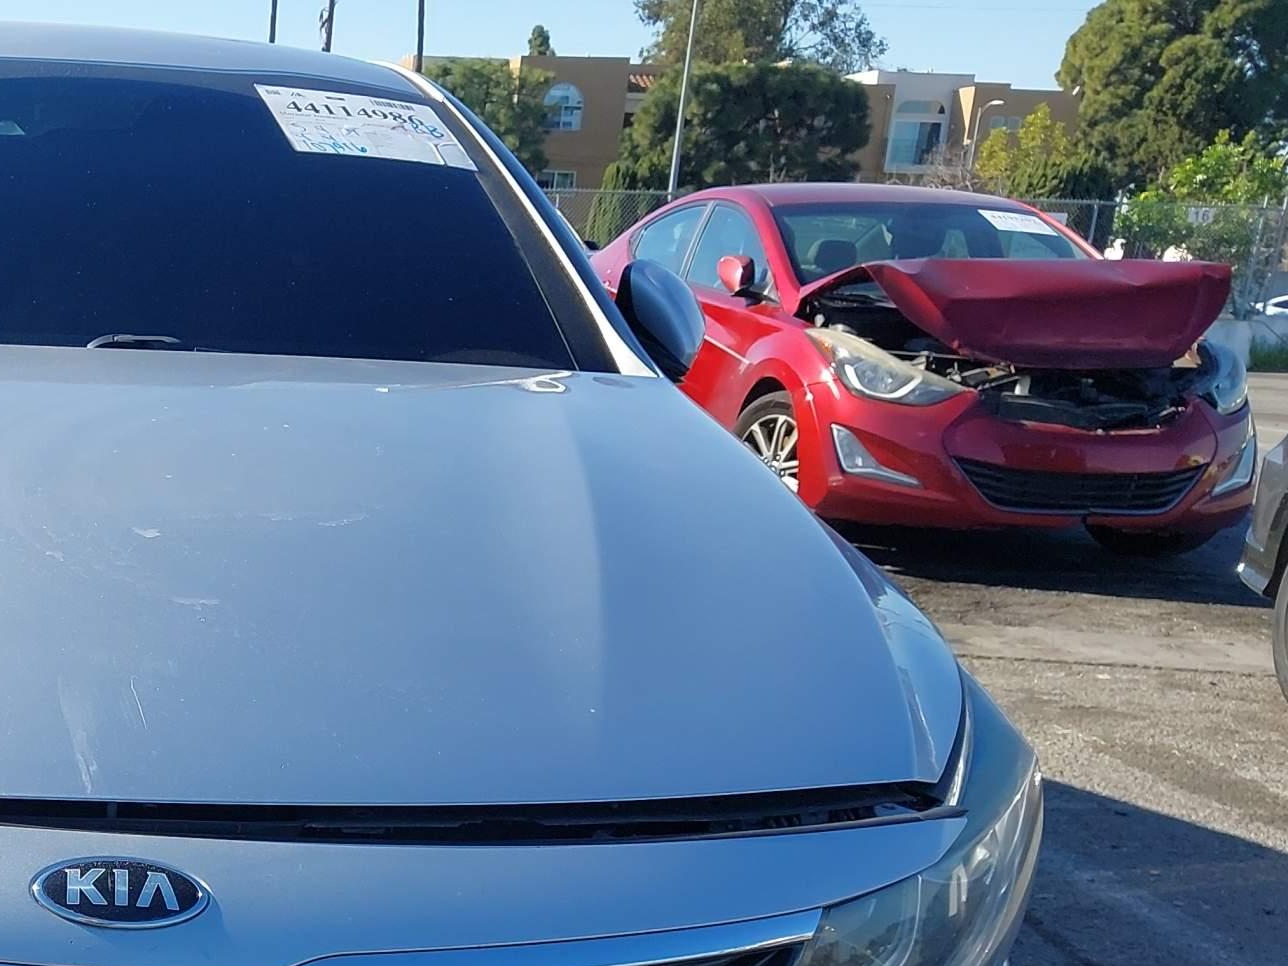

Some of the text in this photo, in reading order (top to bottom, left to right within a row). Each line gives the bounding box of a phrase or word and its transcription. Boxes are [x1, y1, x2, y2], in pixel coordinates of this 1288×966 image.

[286, 100, 424, 126] 44114986
[1193, 210, 1210, 222] 16
[64, 868, 180, 911] KIA
